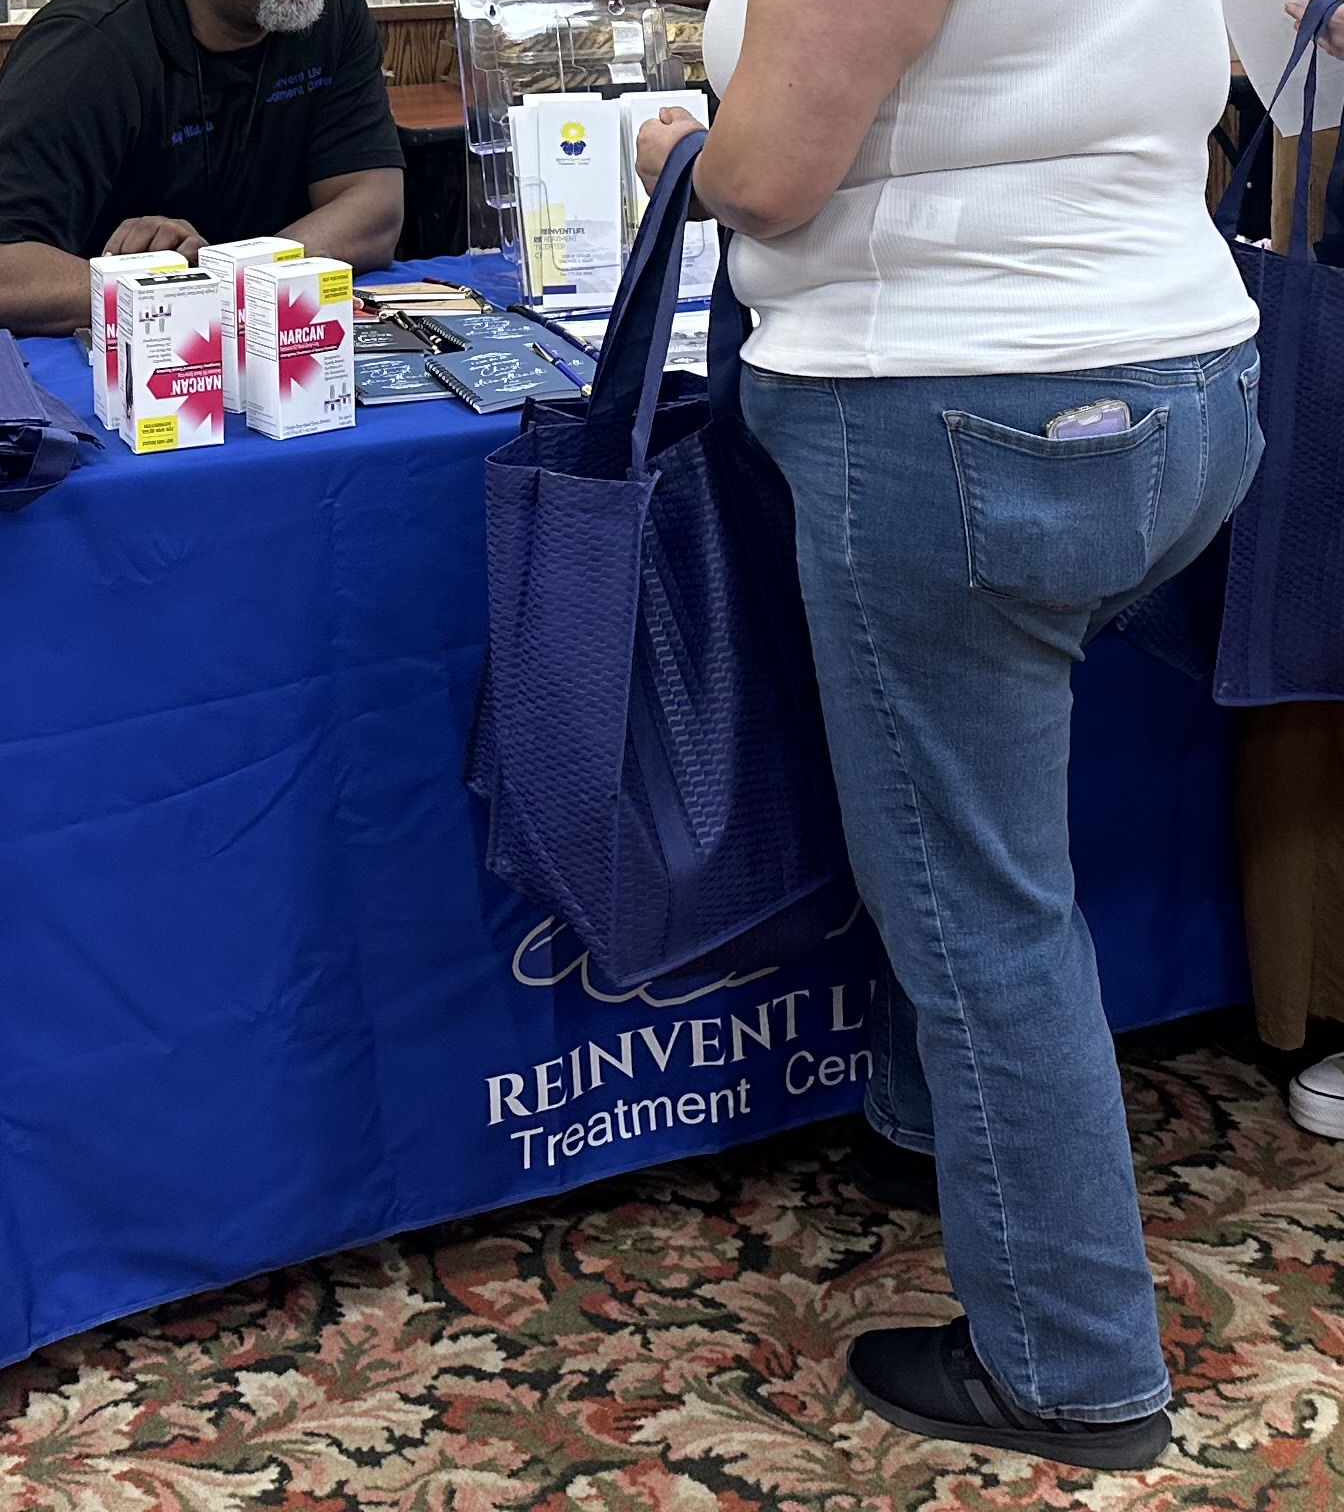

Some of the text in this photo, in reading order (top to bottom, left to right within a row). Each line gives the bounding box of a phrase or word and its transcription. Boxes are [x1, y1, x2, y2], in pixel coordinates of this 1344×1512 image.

[279, 325, 325, 345] NARCAN
[172, 374, 222, 395] NARCAN
[485, 980, 876, 1127] REINVENT L
[510, 1049, 875, 1170] Treatment Cen
